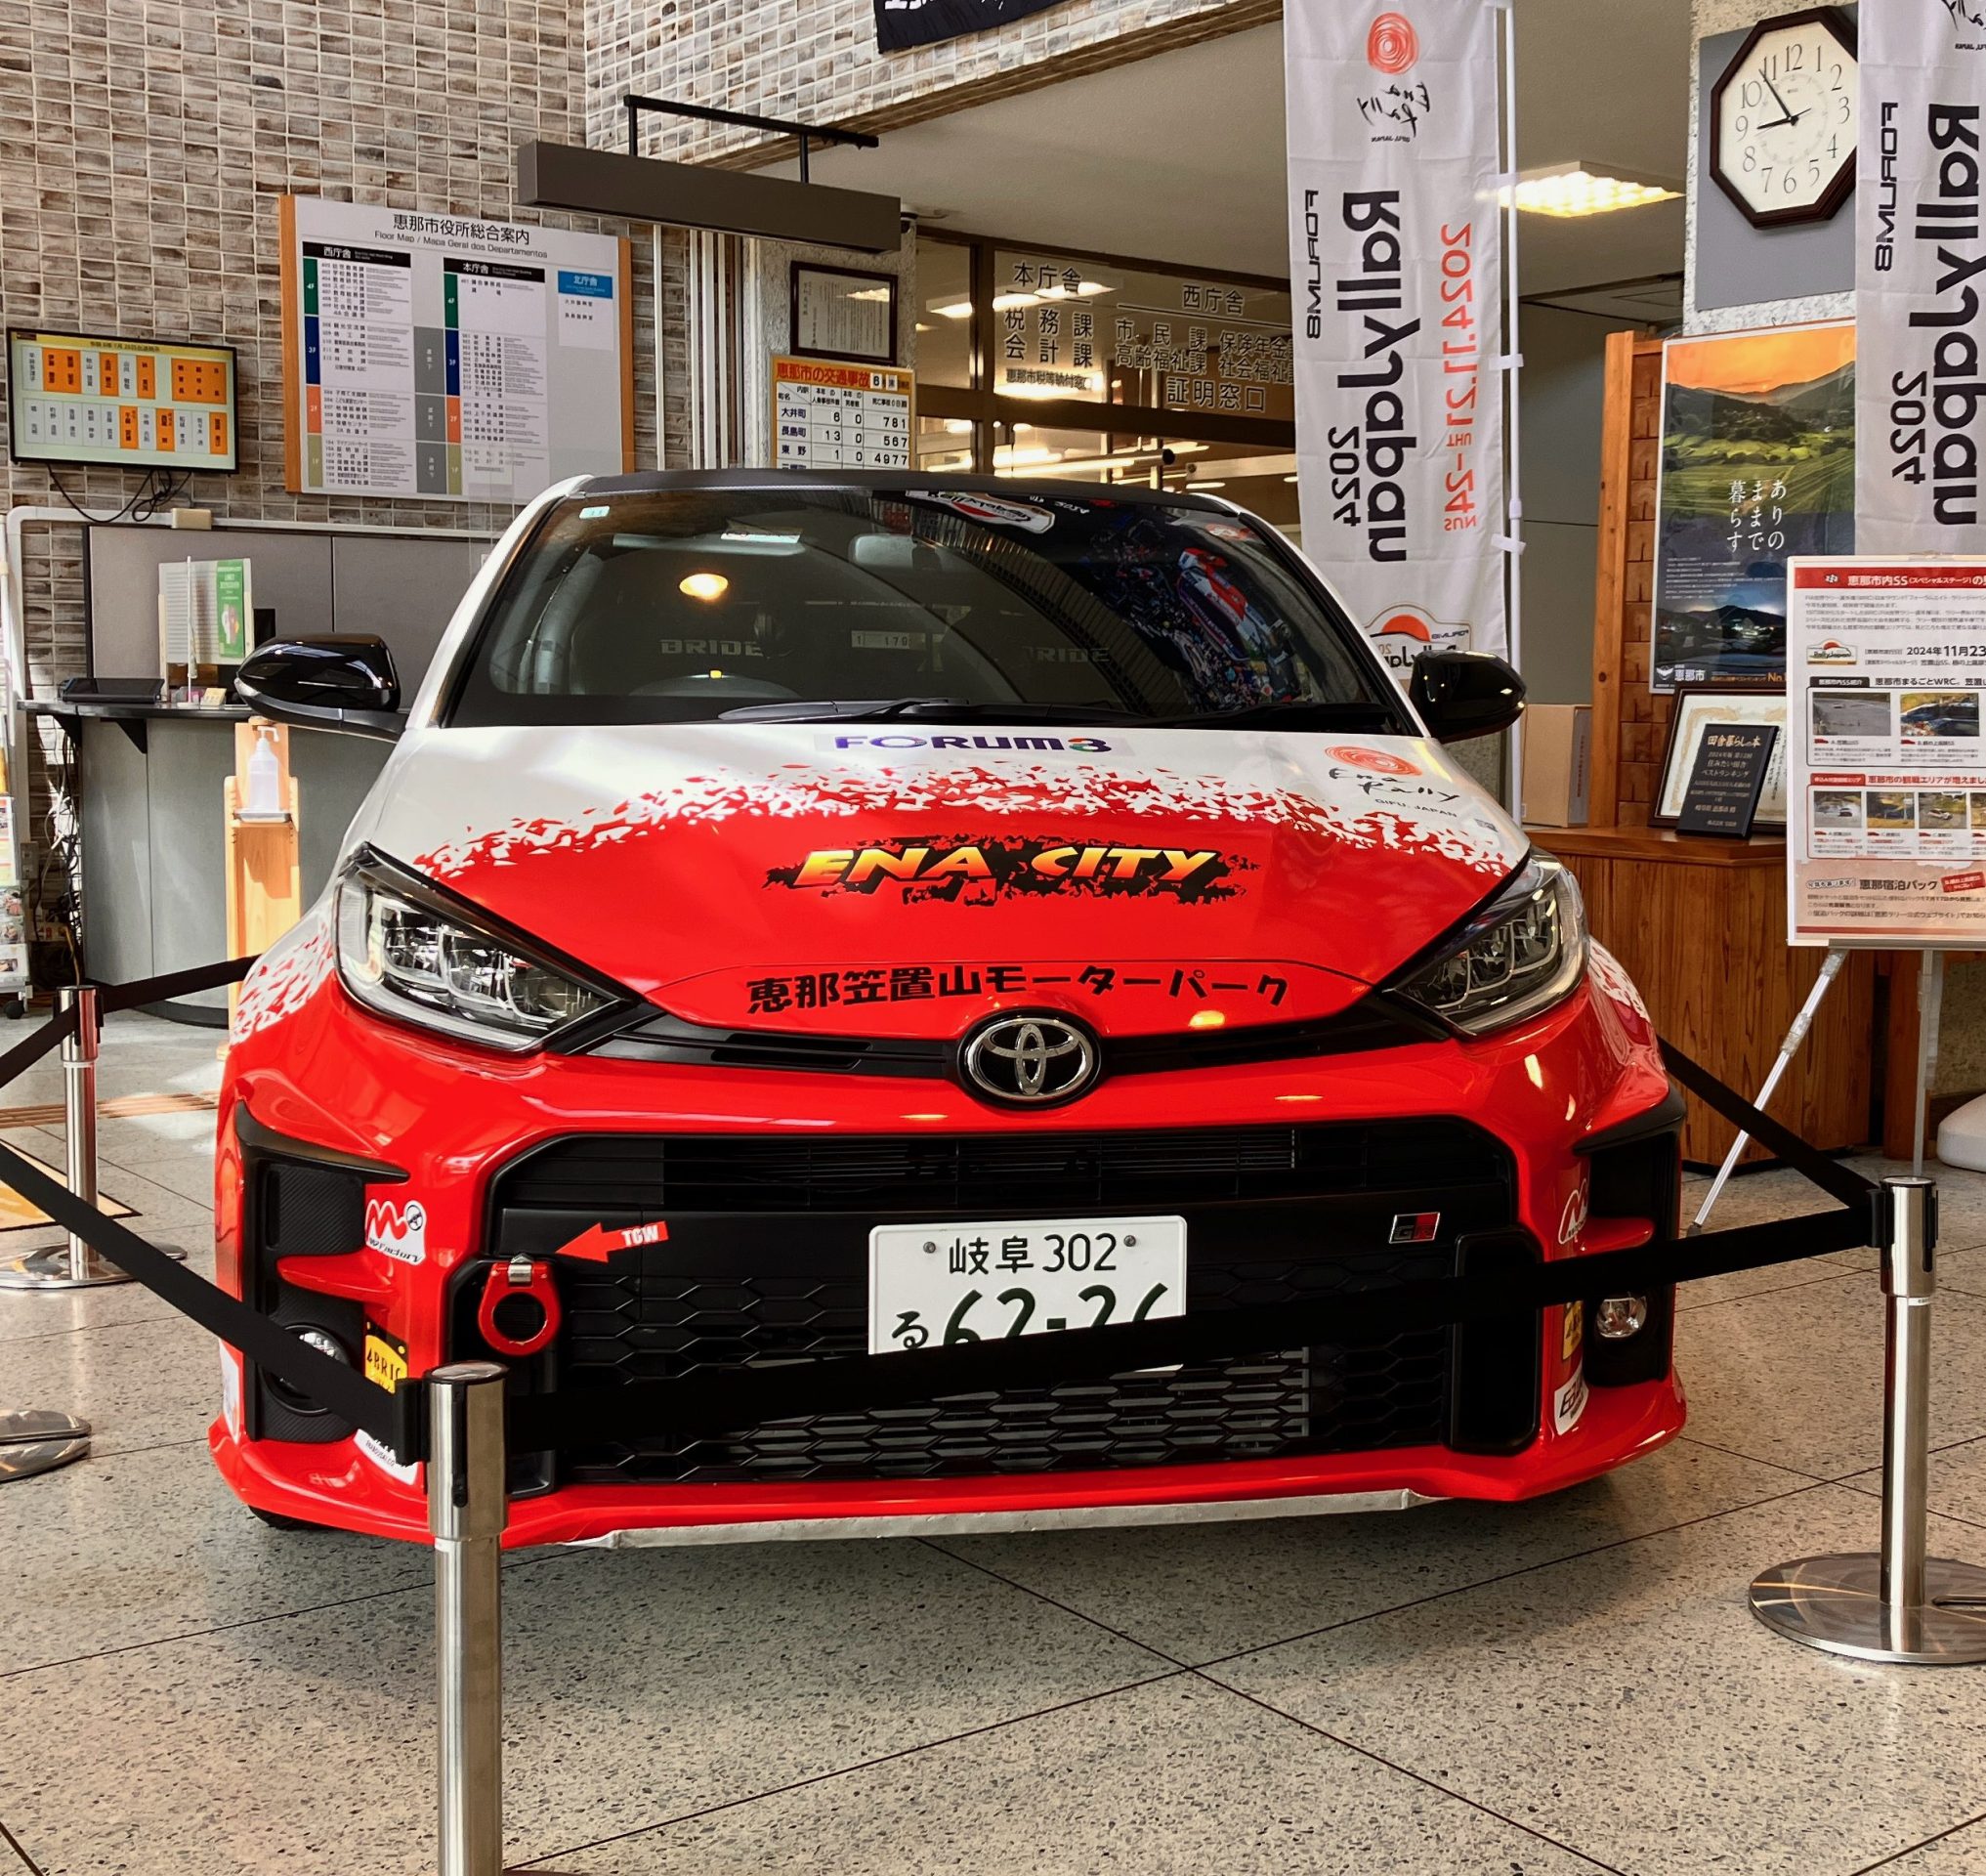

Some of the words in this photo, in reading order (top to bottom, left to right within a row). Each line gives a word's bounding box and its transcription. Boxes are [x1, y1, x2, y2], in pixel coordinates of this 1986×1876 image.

[1763, 55, 1777, 82] 11
[1786, 44, 1802, 72] 12
[1831, 64, 1842, 91] 2
[1741, 81, 1762, 108] 10
[1838, 97, 1850, 124] 3
[1736, 115, 1749, 142] 9
[1743, 146, 1756, 172] 8
[1827, 133, 1838, 159] 4
[1761, 166, 1773, 192] 7
[1783, 167, 1796, 193] 6
[1808, 158, 1820, 187] 5
[393, 213, 529, 245] 恵那市役所総合案内
[323, 246, 352, 259] 西庁舎
[374, 230, 395, 240] Floor
[397, 234, 415, 244] Map
[423, 236, 446, 246] Mapa
[447, 239, 469, 249] Geral
[471, 242, 486, 251] dos
[487, 243, 548, 259] Departamentos
[462, 263, 489, 275] 本庁舎
[573, 276, 598, 287] 北庁舎
[1014, 262, 1081, 294] 本庁舎
[1183, 284, 1244, 315] 西庁舎
[1005, 307, 1093, 338] 税務課
[1116, 319, 1206, 352] 市民課
[1005, 333, 1093, 368] 会計課
[1116, 344, 1206, 375] 高齢福祉課
[777, 362, 870, 387] 恵那市の交通事故
[1167, 377, 1266, 412] 証明窓口
[782, 407, 807, 419] 大井町
[855, 414, 862, 424] 0
[883, 417, 907, 429] 781
[782, 426, 807, 437] 長島町
[825, 430, 840, 441] 13
[855, 433, 862, 444] 0
[883, 436, 908, 448] 567
[856, 451, 863, 462] 0
[874, 453, 908, 465] 4977
[1727, 480, 1747, 553] 暮らす
[1748, 480, 1765, 552] ままで
[1768, 480, 1787, 550] ありの
[660, 639, 763, 657] BRIDE
[1674, 669, 1706, 681] 恵那市
[794, 846, 993, 886] ENA
[1031, 846, 1216, 881] CITY
[746, 963, 1289, 1014] 恵那笠置山モーターパーク
[949, 1235, 1035, 1275] 岐阜
[1042, 1232, 1118, 1272] 302
[891, 1310, 929, 1350] る
